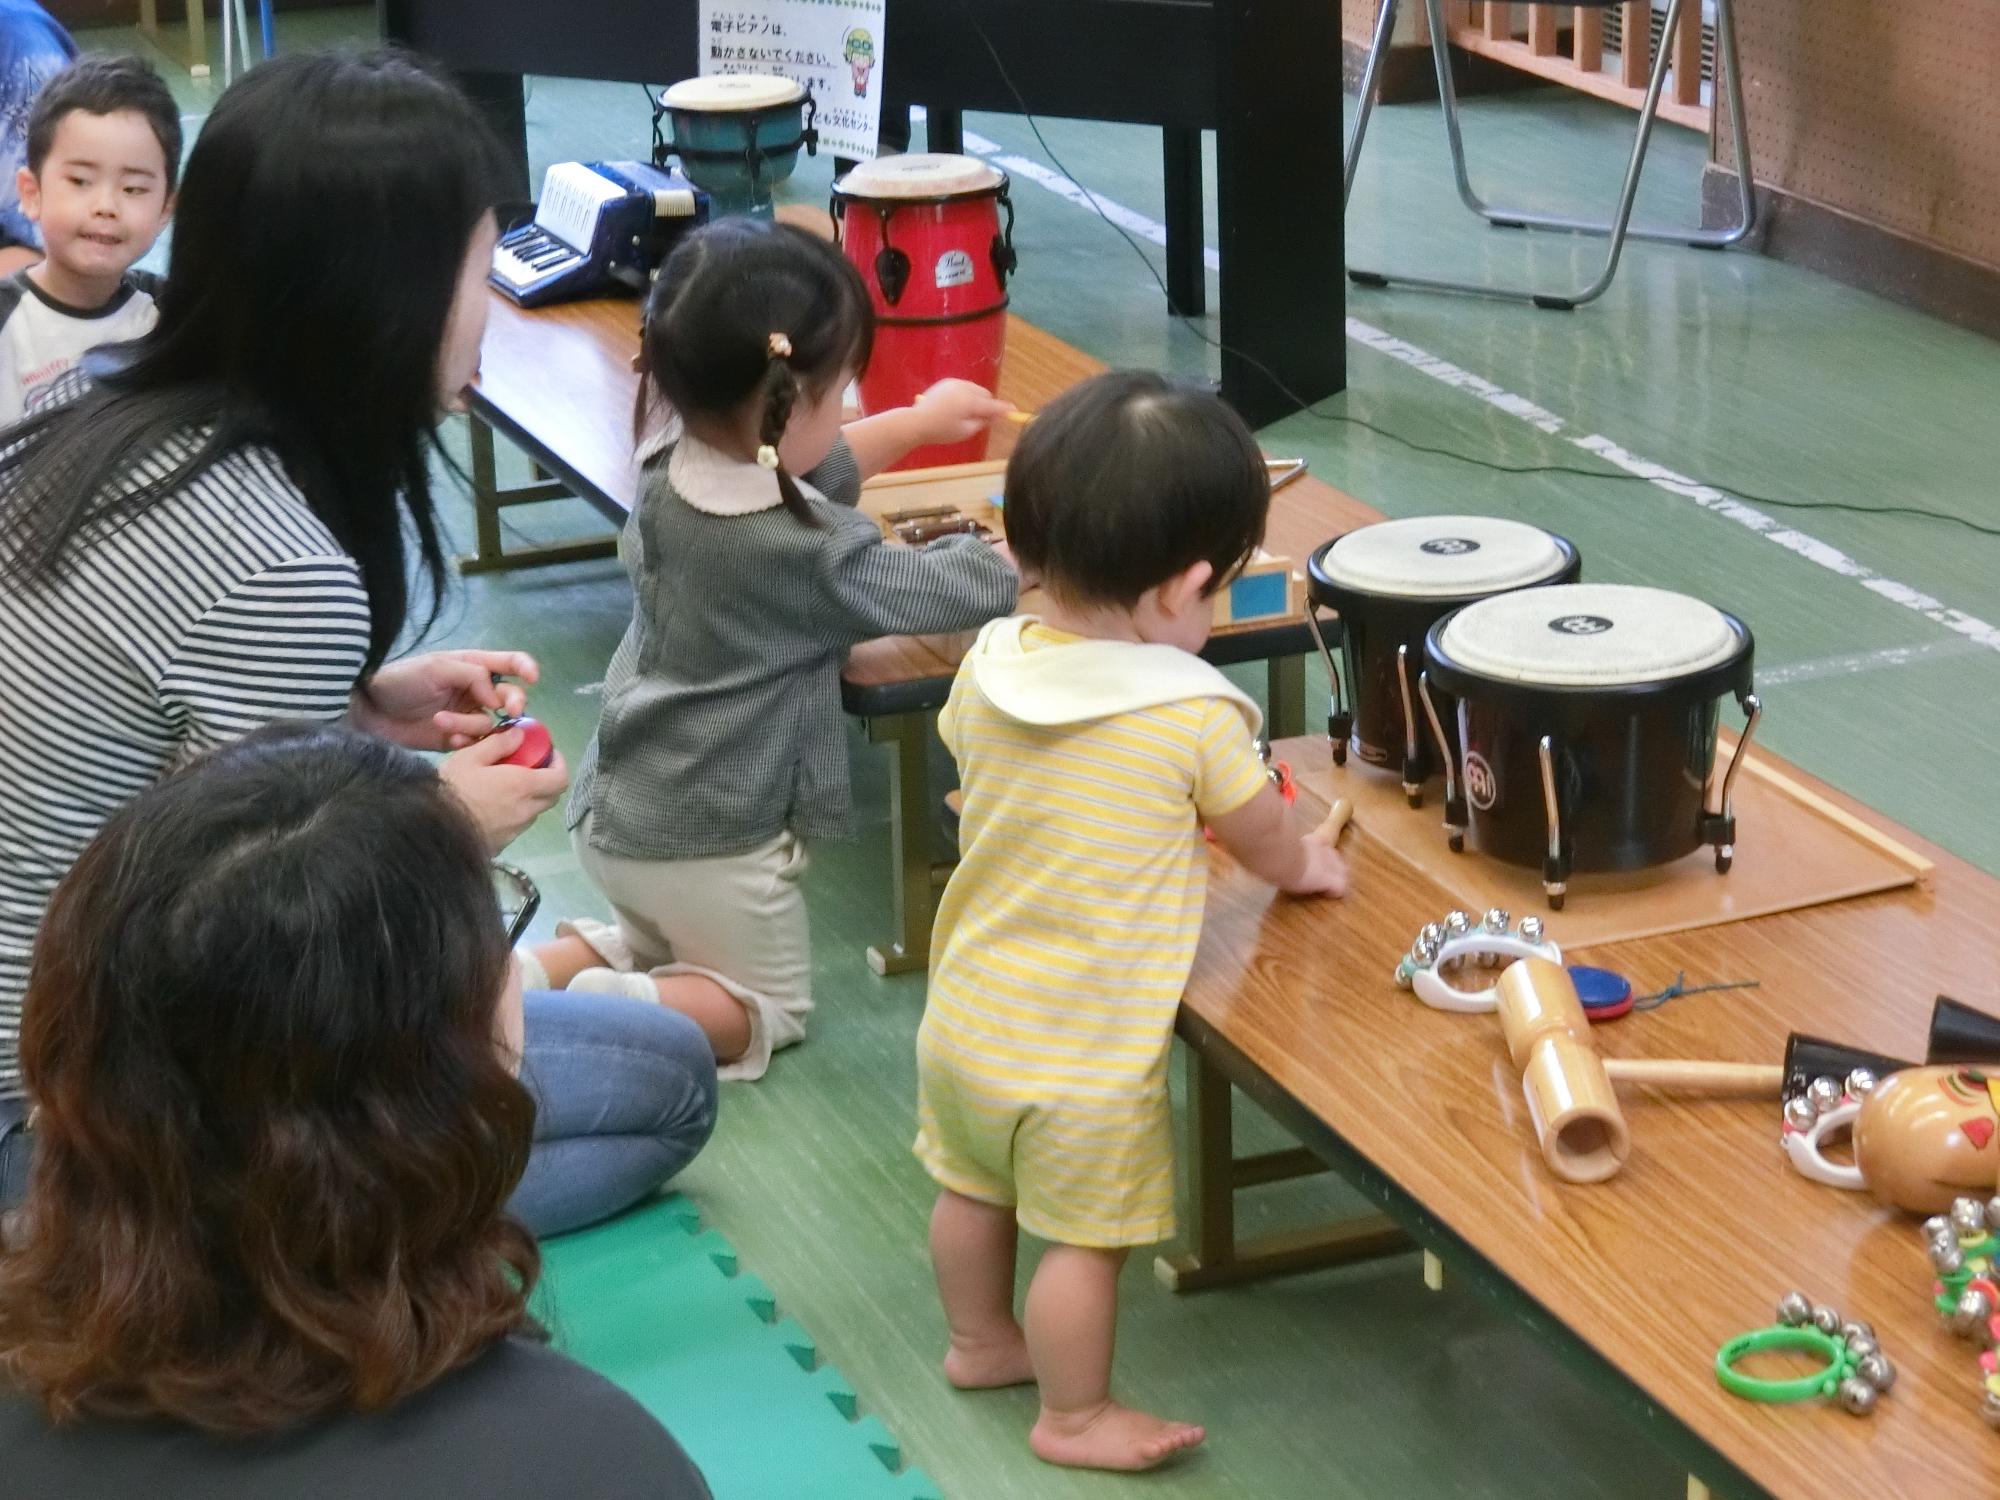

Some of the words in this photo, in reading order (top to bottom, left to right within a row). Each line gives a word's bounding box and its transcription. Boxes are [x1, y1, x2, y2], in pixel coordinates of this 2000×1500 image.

[711, 45, 831, 66] 動かさないでください。
